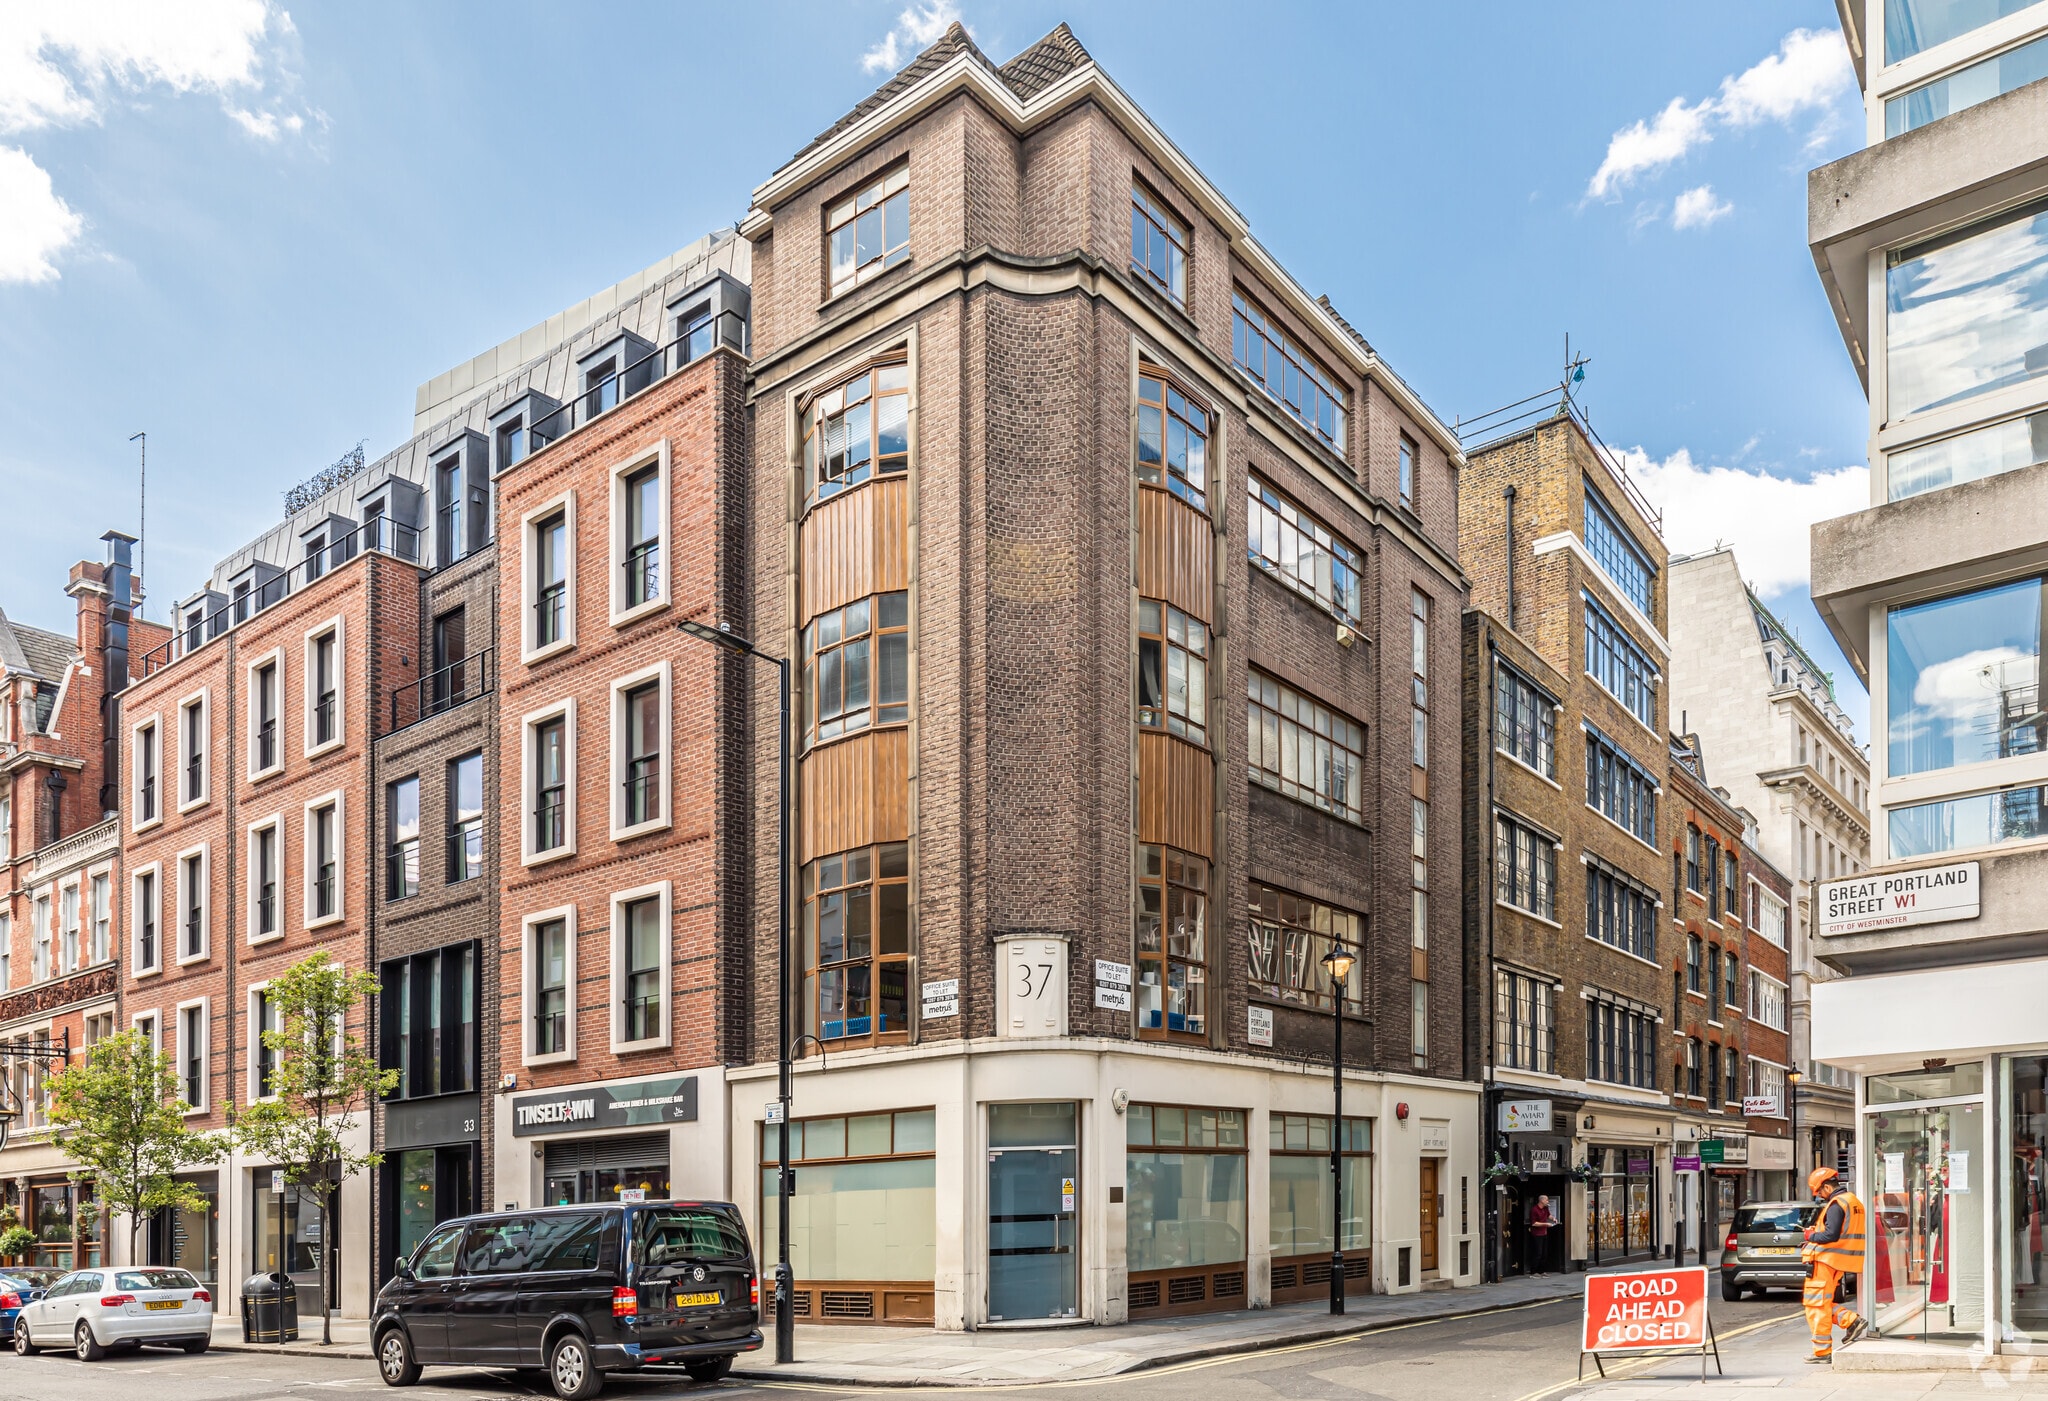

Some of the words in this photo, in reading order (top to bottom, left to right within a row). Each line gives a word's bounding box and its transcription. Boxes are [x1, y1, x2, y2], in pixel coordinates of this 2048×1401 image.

[1829, 882, 1877, 901] GREAT
[1884, 869, 1968, 894] PORTLAND
[1829, 897, 1884, 917] STREET
[1894, 893, 1916, 909] W1
[1829, 924, 1844, 932] CITY
[1846, 922, 1855, 930] OF
[1858, 915, 1908, 928] WESTMINSTER
[1097, 962, 1114, 972] OFFICE
[1115, 965, 1129, 975] SUITE
[1016, 963, 1053, 1001] 37
[1105, 971, 1112, 979] TO
[1112, 973, 1122, 981] LET
[925, 982, 942, 991] OFFICE
[942, 980, 955, 988] SUITE
[1250, 1009, 1263, 1018] LITTLE
[1250, 1018, 1270, 1029] PORTLAND
[1250, 1027, 1265, 1036] STREET
[608, 1101, 631, 1110] AMERICAN
[649, 1096, 674, 1105] MILKSHAKE
[674, 1095, 683, 1103] BAR
[1526, 1103, 1540, 1111] THE
[464, 1119, 475, 1132] 33
[1530, 1149, 1558, 1161] PORTLAND
[1613, 1278, 1678, 1299] ROAD
[1605, 1299, 1685, 1322] AHEAD
[1597, 1321, 1691, 1343] CLOSED
